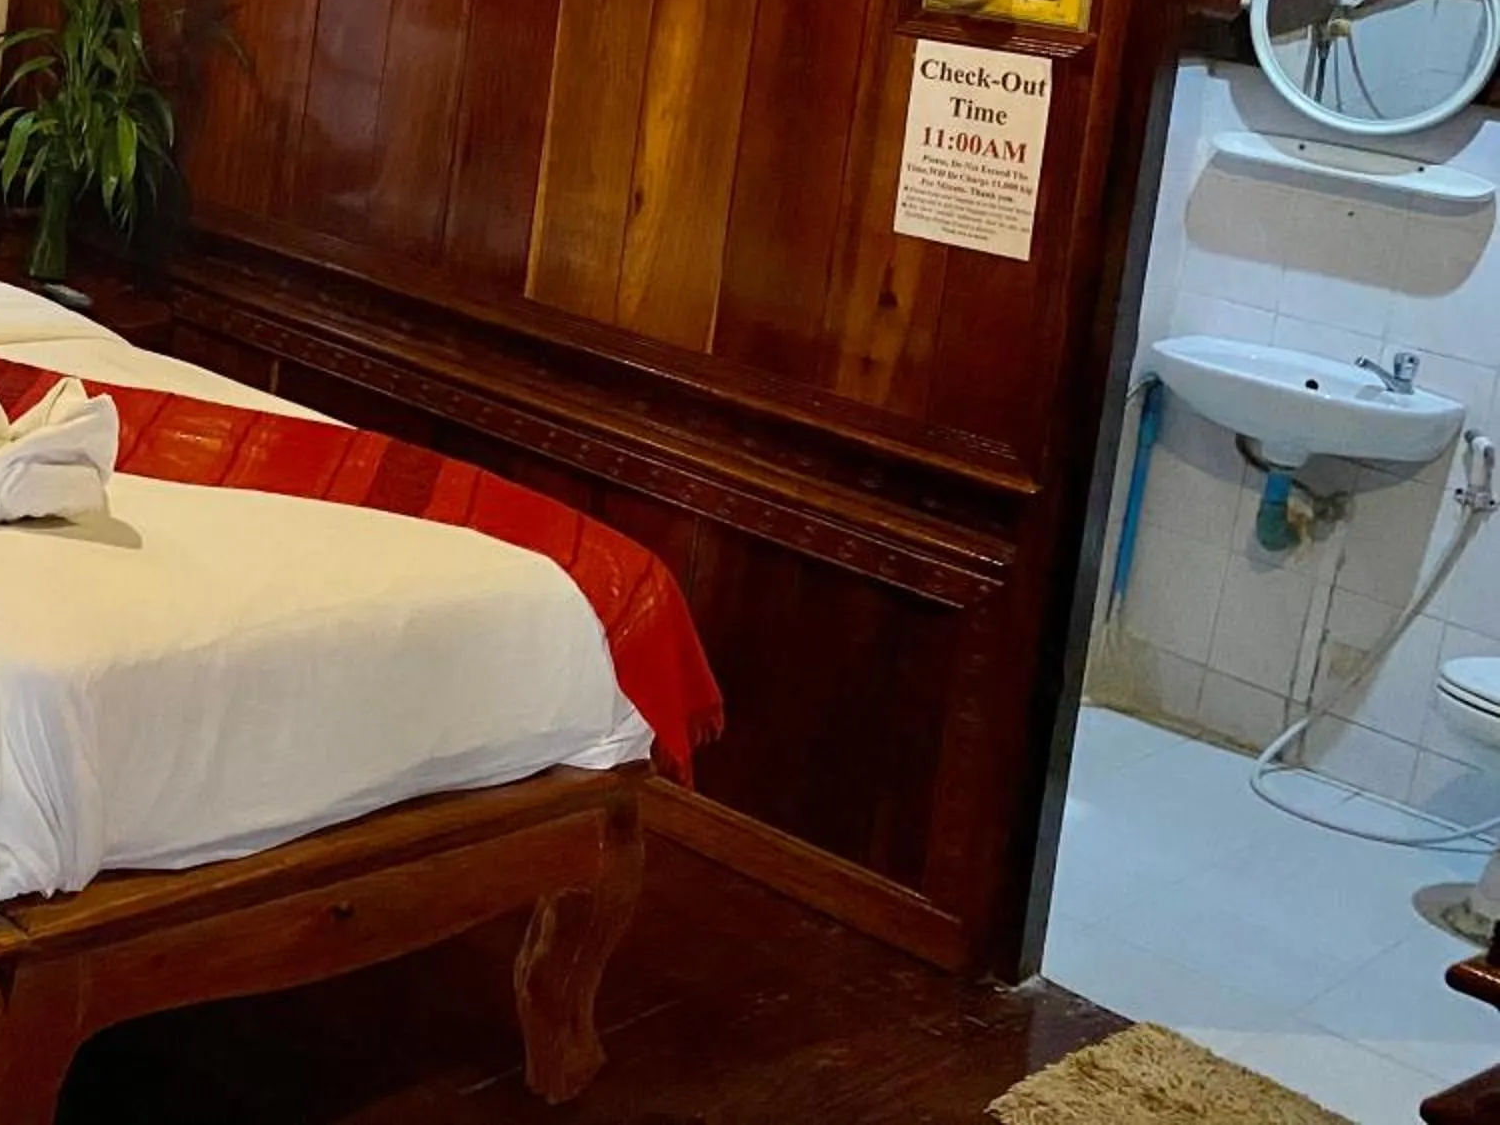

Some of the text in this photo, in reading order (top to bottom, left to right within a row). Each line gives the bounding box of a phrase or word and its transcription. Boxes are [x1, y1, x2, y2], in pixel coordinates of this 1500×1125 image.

[920, 58, 1046, 97] Check-Out
[949, 96, 1008, 125] Time
[923, 126, 1027, 163] 11:00AM
